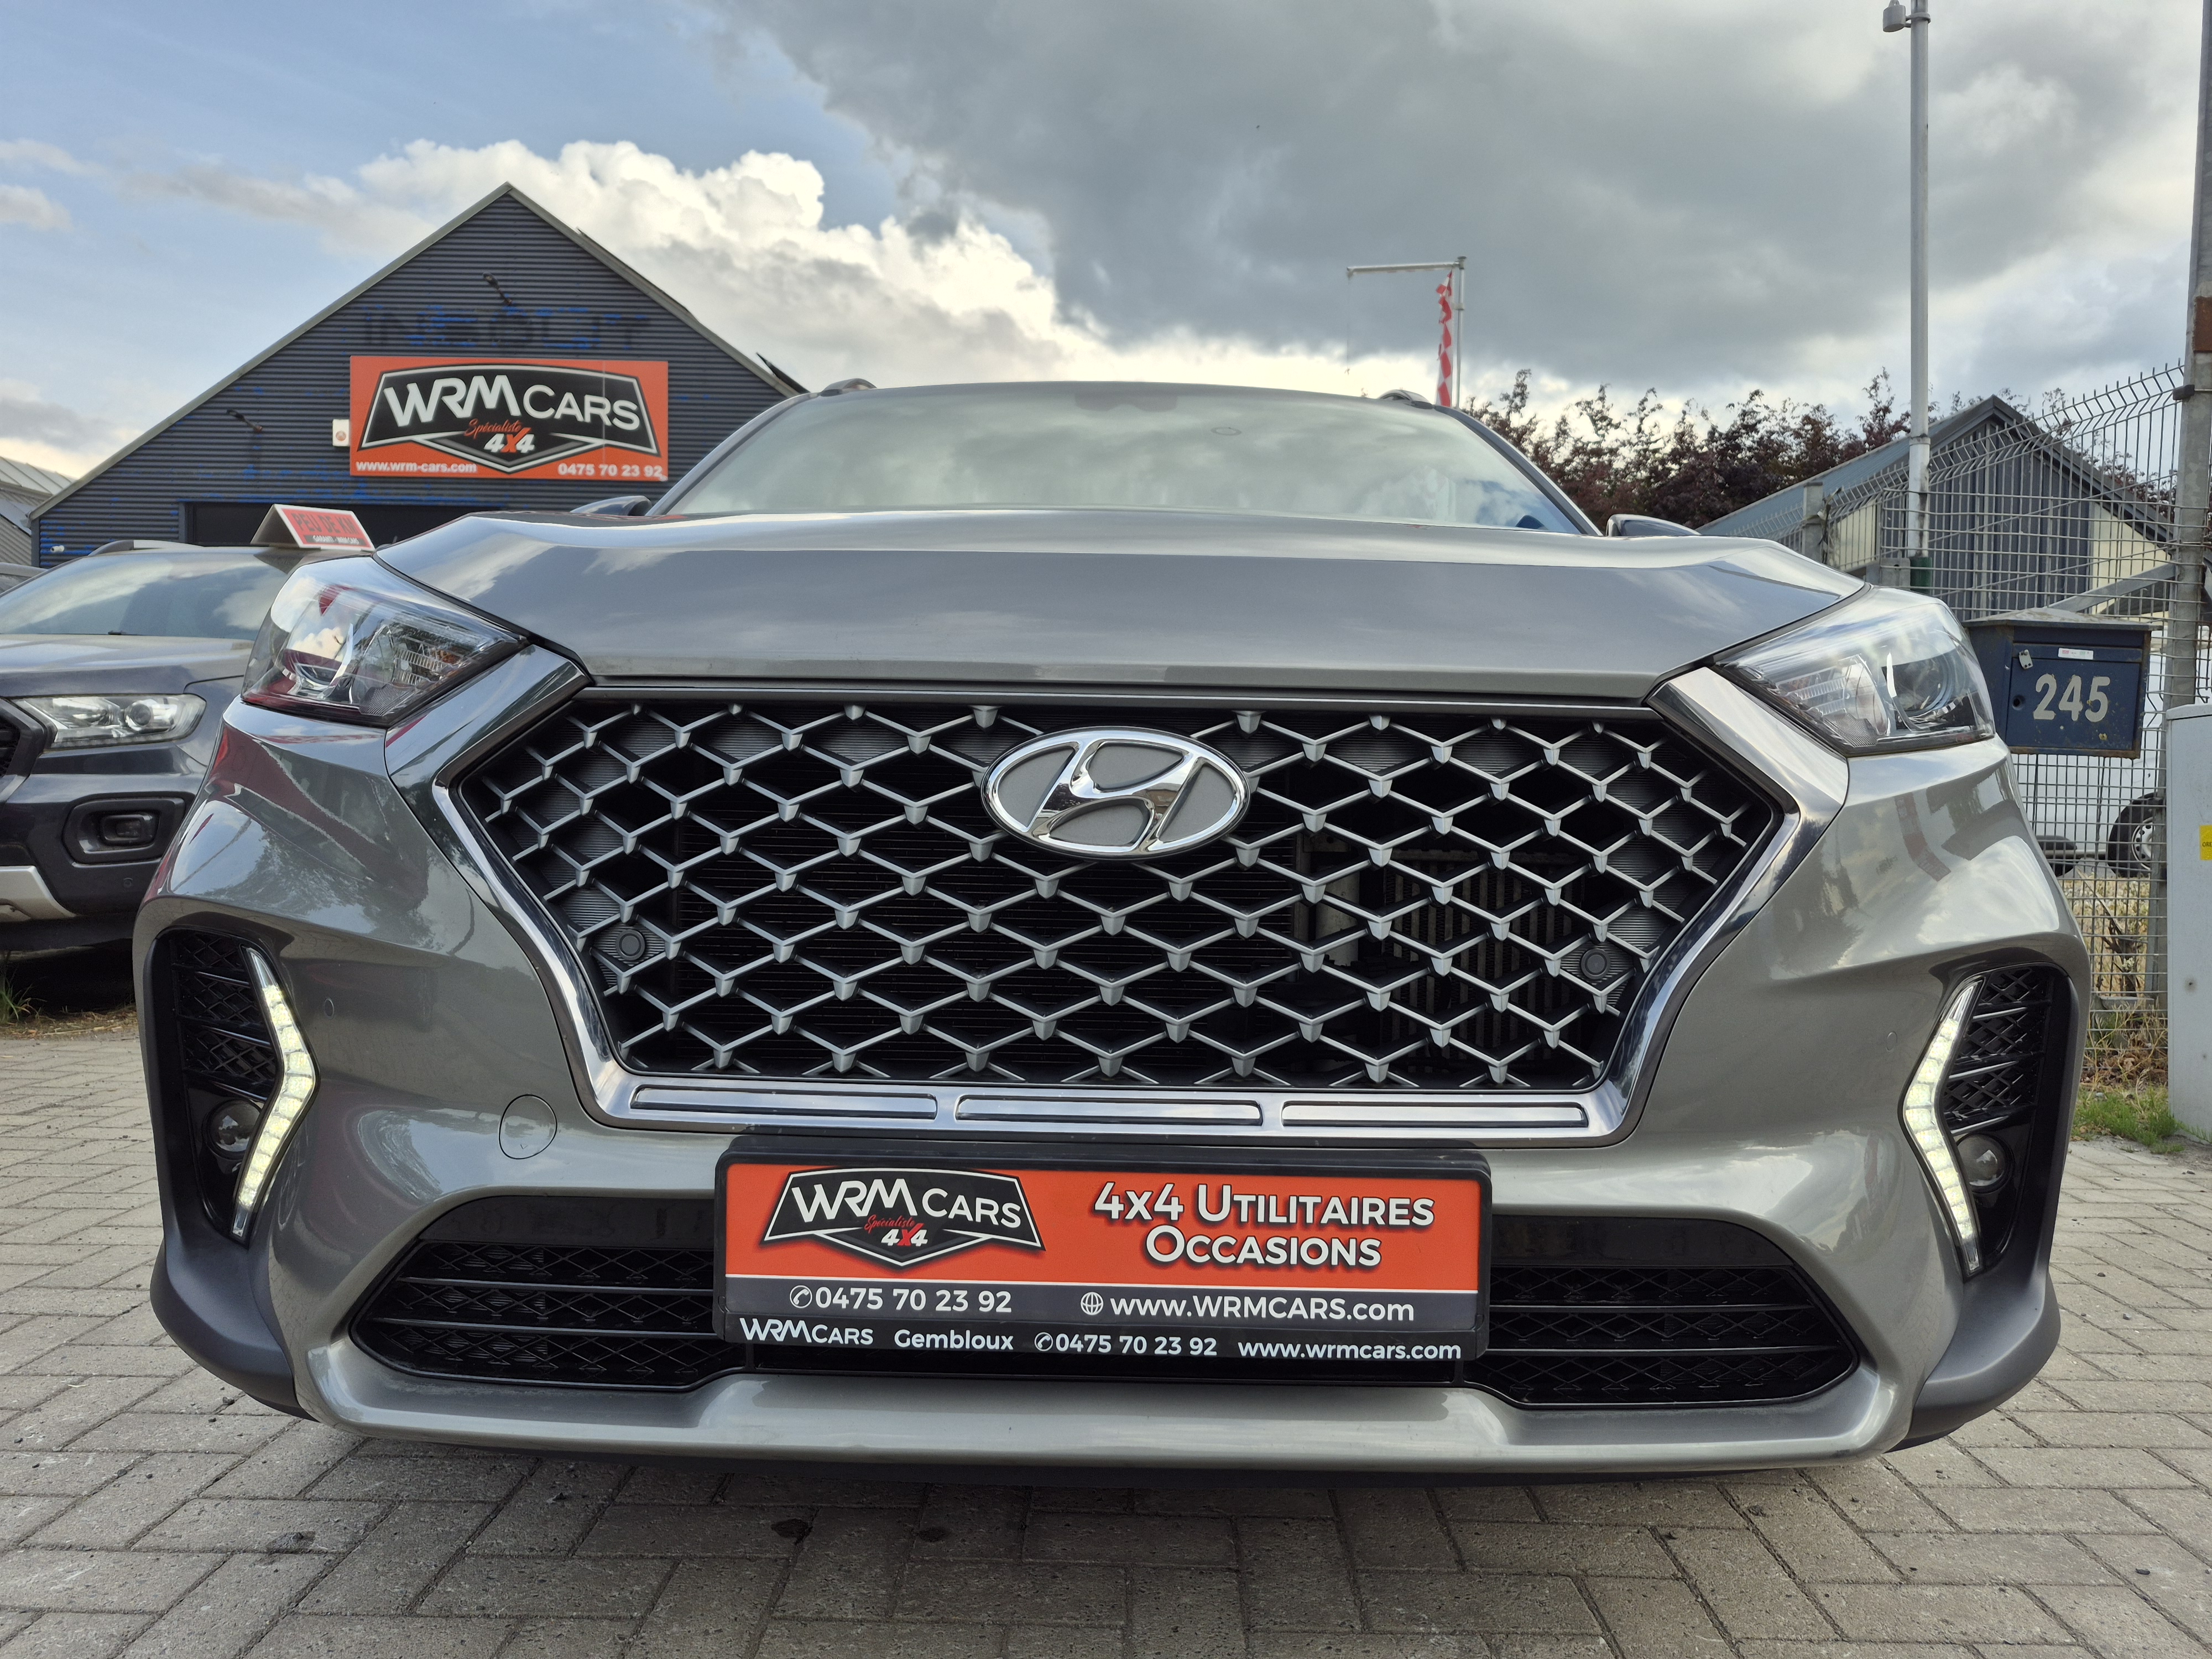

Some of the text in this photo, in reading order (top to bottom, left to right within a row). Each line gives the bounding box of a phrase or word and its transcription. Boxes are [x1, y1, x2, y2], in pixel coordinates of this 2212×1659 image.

[356, 461, 477, 473] www.wrm-cars.com
[558, 463, 664, 478] 0475 70 23 92
[291, 513, 322, 533] PEU
[318, 515, 341, 534] DE
[2033, 673, 2111, 723] 245
[1094, 1182, 1185, 1220] 4x4
[815, 1286, 1013, 1313] 0475 70 23 92
[1110, 1295, 1414, 1321] www.WRMCARS.com
[894, 1329, 1014, 1351] Gembloux
[1055, 1333, 1112, 1354] 0475
[1119, 1335, 1147, 1354] 70
[1154, 1336, 1182, 1355] 23
[1189, 1337, 1218, 1356] 92
[1238, 1342, 1461, 1360] www.wrmcars.com
